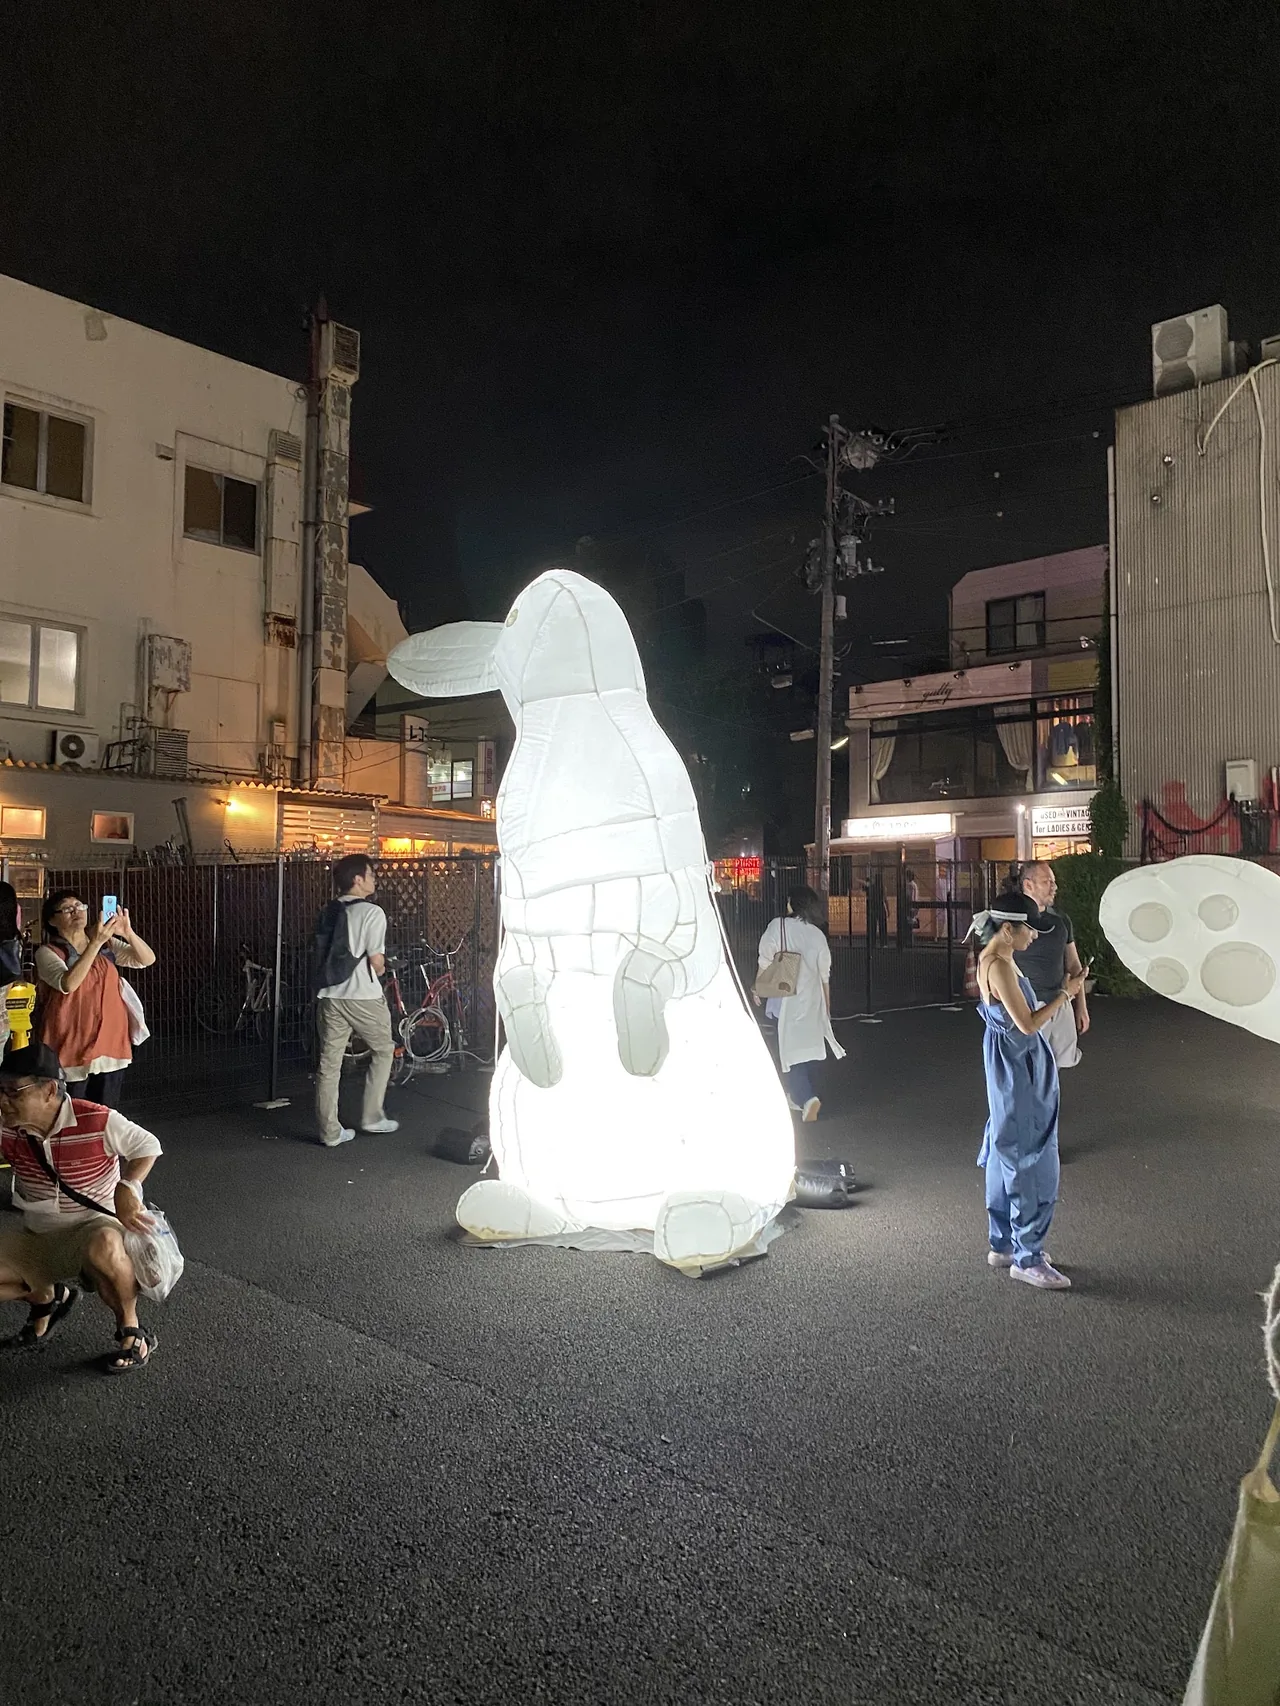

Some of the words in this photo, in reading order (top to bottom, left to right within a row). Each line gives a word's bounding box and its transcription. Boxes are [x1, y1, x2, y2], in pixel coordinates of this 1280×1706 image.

[1066, 809, 1090, 818] VINTAG
[1036, 825, 1045, 833] for
[1047, 823, 1070, 833] LADIES
[1071, 823, 1076, 832] &
[1077, 823, 1091, 832] GEN
